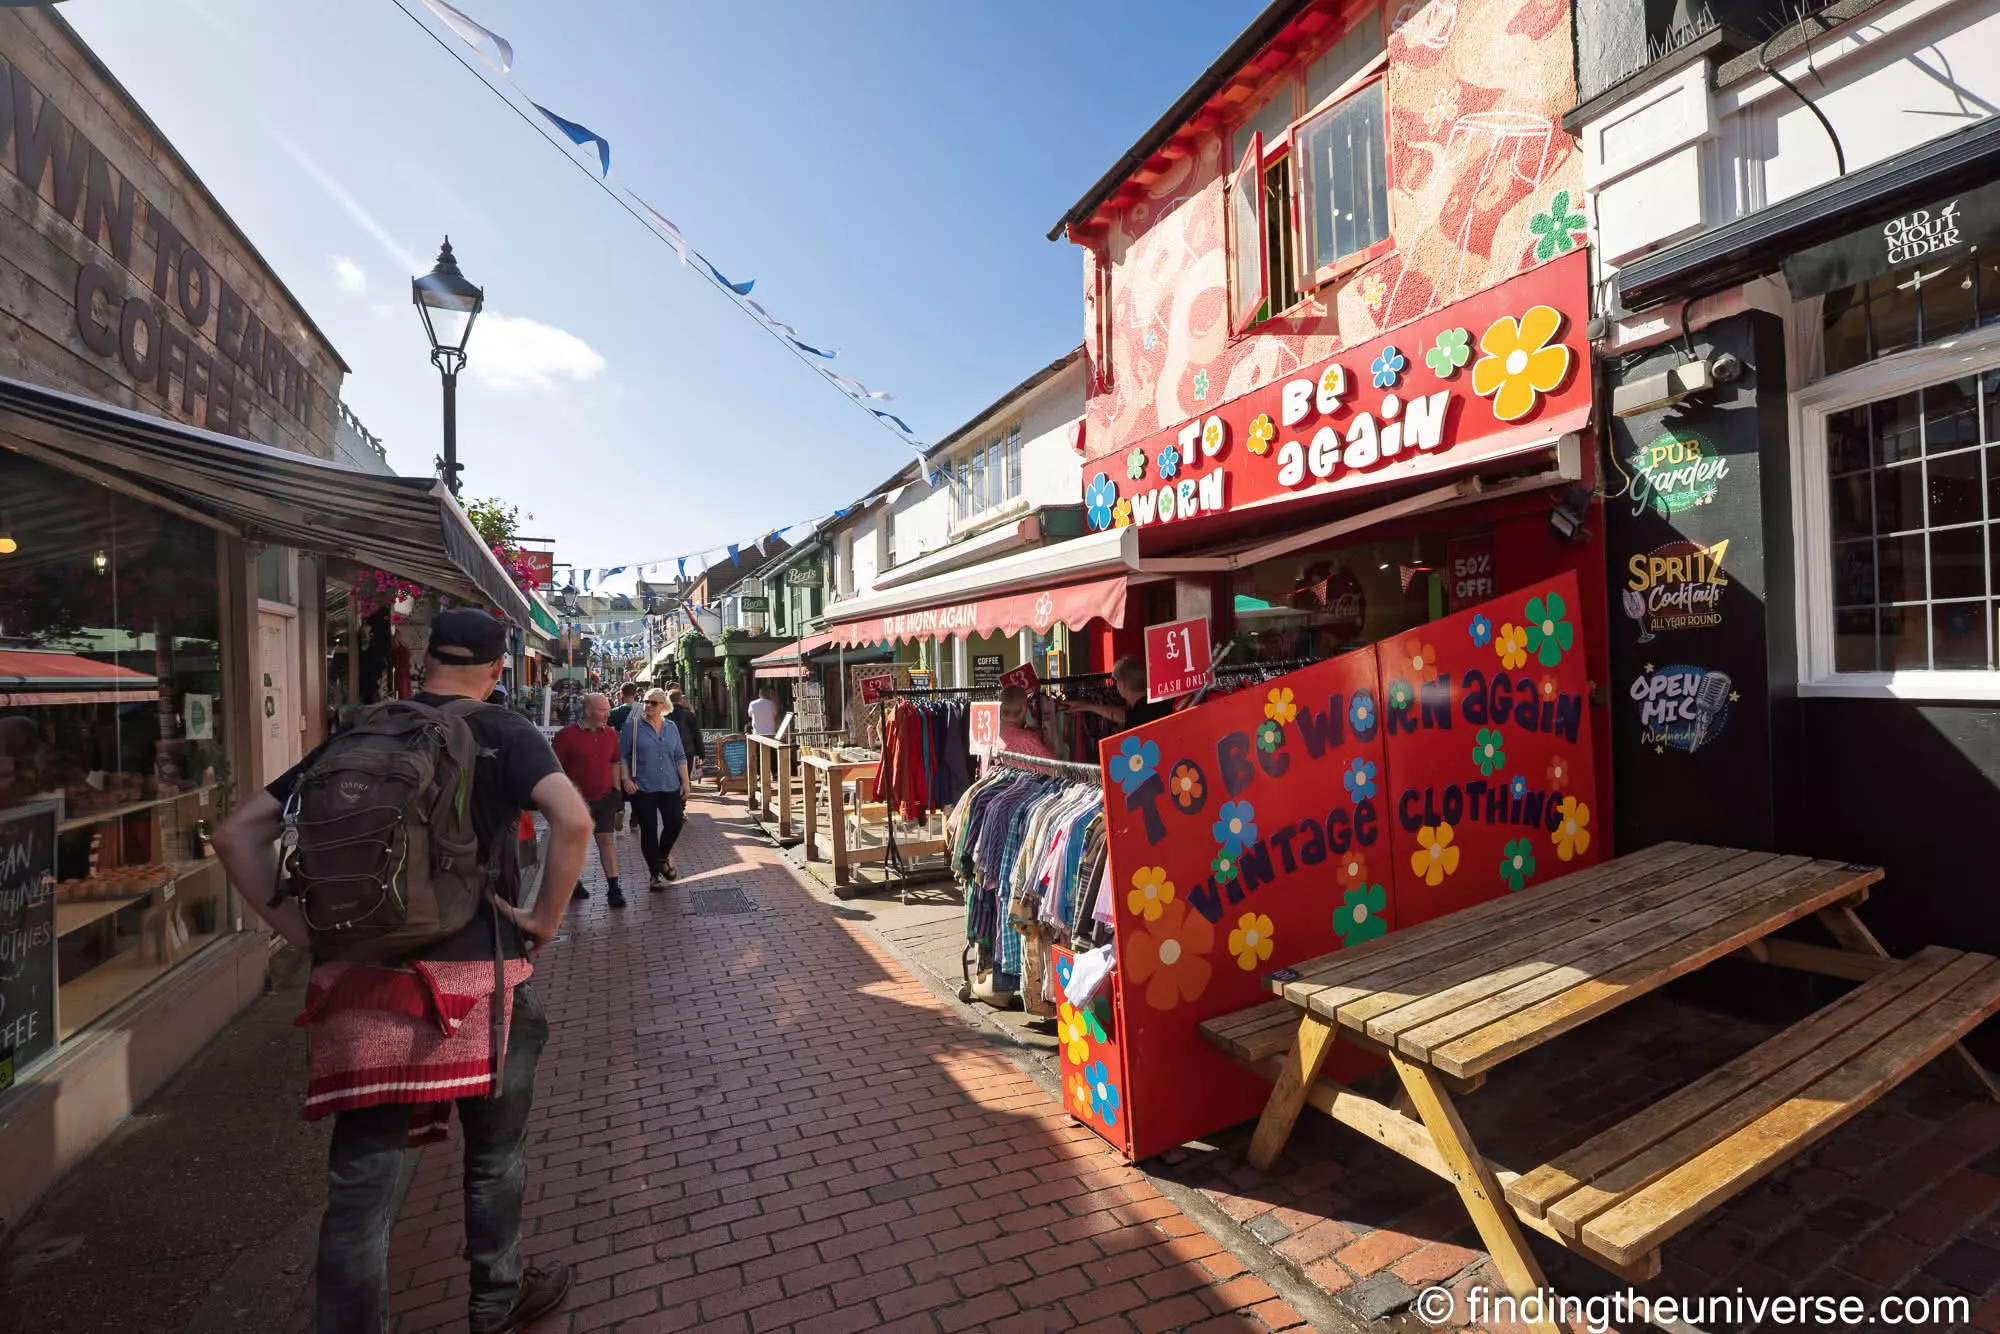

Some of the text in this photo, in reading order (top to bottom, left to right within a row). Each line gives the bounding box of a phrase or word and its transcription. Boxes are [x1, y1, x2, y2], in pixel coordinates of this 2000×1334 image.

[1883, 210, 1930, 236] OLD
[1884, 211, 1960, 251] MOUT
[1887, 228, 1963, 264] CIDER
[146, 201, 210, 326] TO
[215, 277, 314, 426] EARTH
[75, 261, 250, 438] COFFEE
[1178, 414, 1226, 466] TO
[1650, 439, 1702, 468] PUB
[1130, 467, 1226, 528] WORN
[1629, 454, 1730, 517] Garden
[1454, 554, 1491, 578] 50%
[1628, 538, 1730, 592] SPRITZ
[1455, 578, 1492, 598] OFF!
[1648, 583, 1720, 614] Cocktails
[883, 602, 978, 635] TO BE WORN AGAIN
[1651, 613, 1722, 631] ALL YEAR ROUND
[977, 656, 1000, 666] COFFEE
[1166, 627, 1195, 673] £1
[1157, 673, 1207, 695] CASH ONLY
[1630, 673, 1702, 701] OPEN
[978, 709, 992, 742] £3
[1641, 696, 1697, 726] MIC
[1125, 758, 1208, 847] TO
[1295, 673, 1453, 760] WORN
